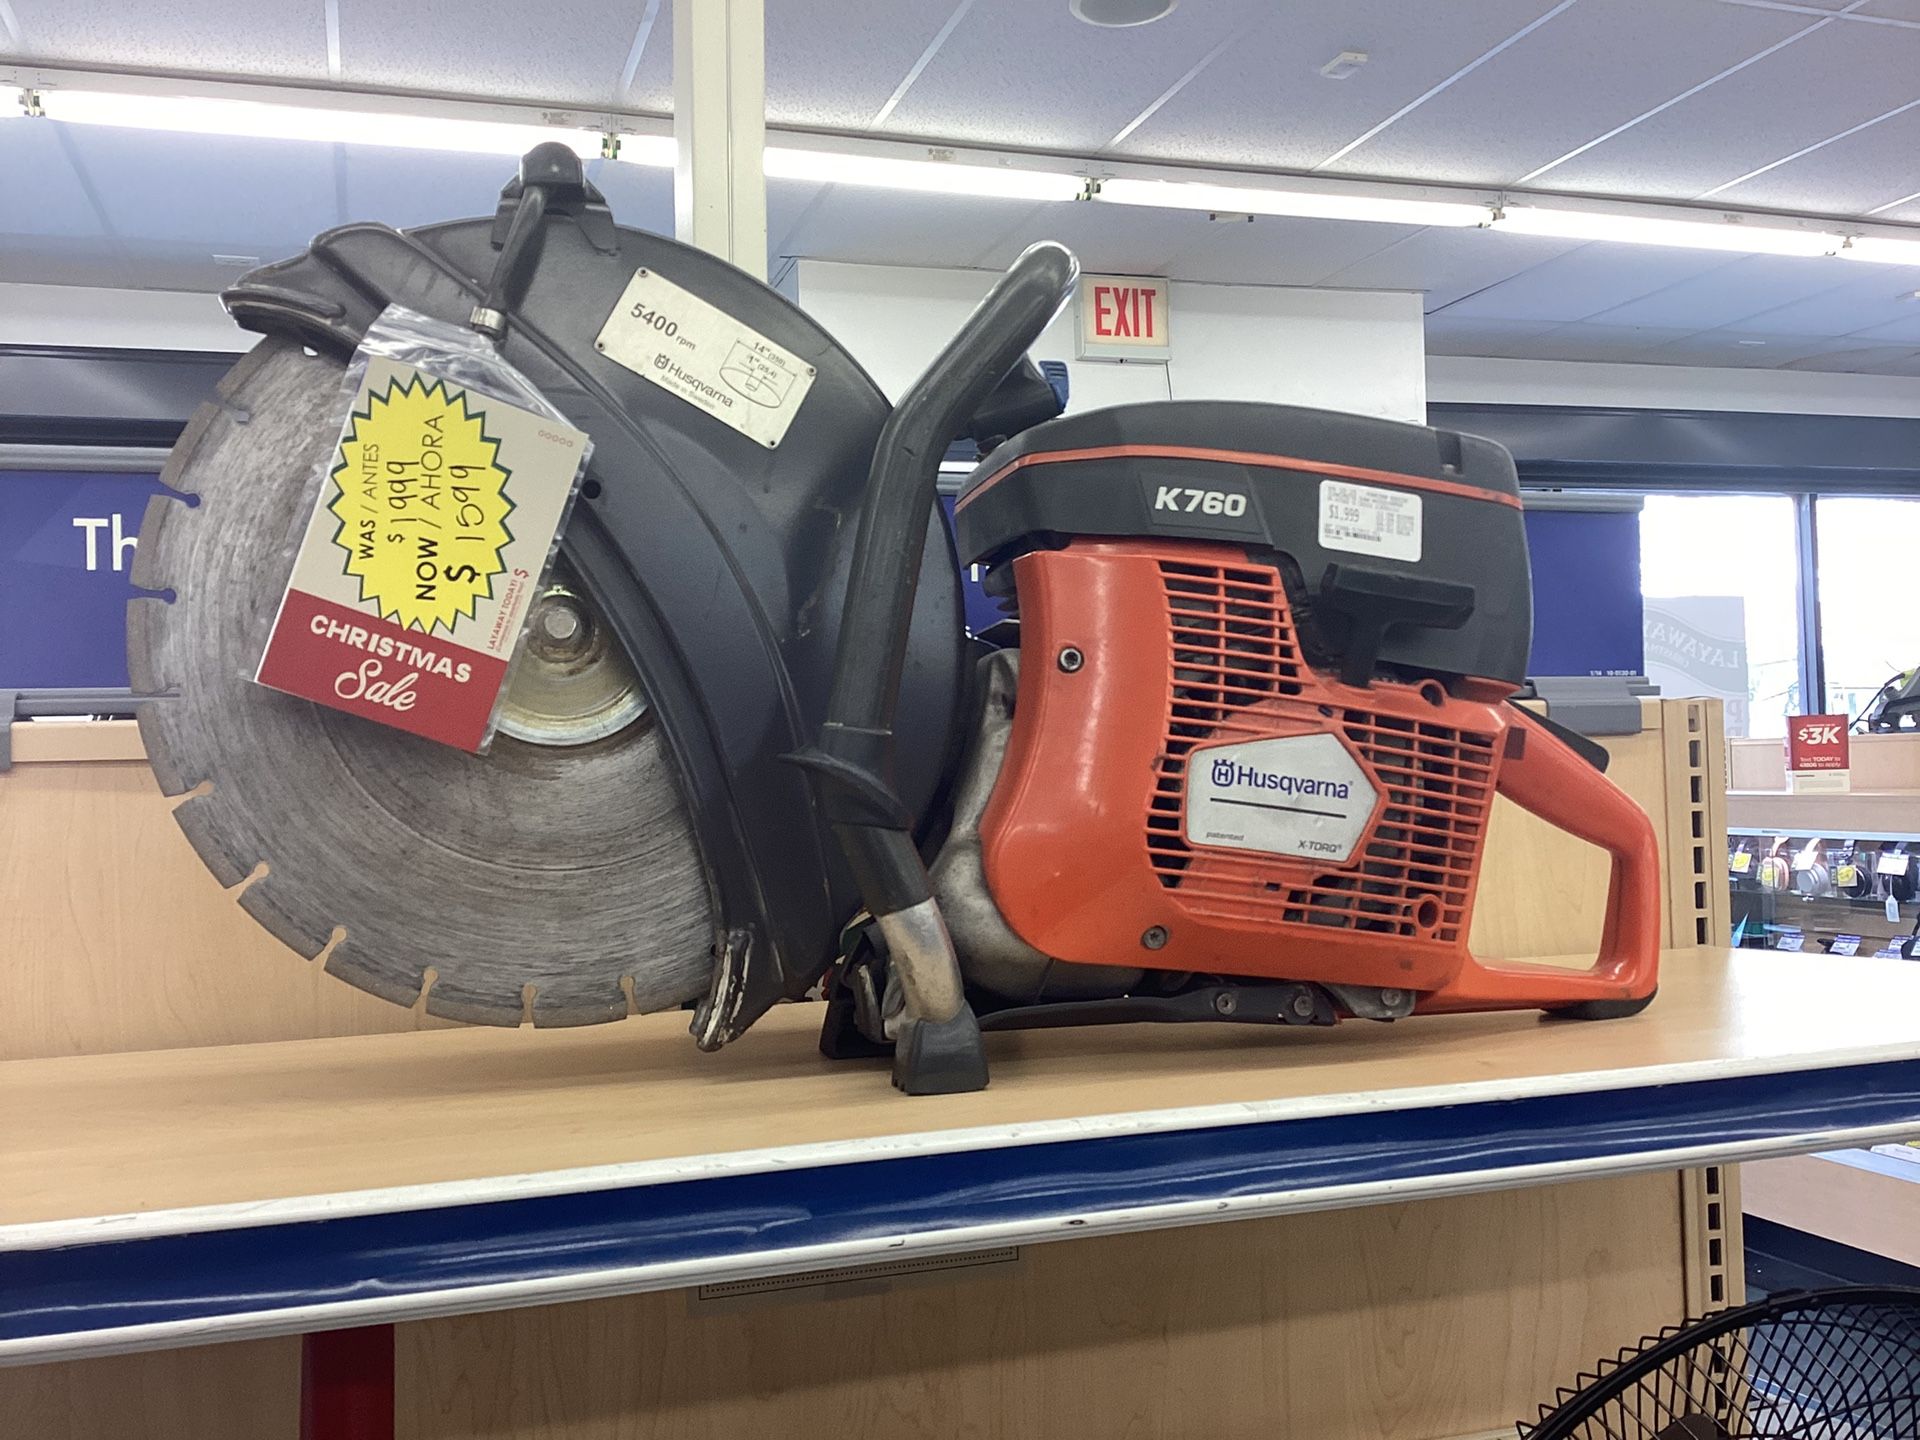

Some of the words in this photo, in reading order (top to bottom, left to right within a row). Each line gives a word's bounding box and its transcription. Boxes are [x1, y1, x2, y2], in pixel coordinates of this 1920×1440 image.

[630, 302, 678, 337] 5400
[675, 335, 697, 351] rpm
[1094, 286, 1156, 338] EXIT
[667, 362, 734, 408] Husqvarna
[362, 443, 380, 500] ANTES
[419, 414, 446, 512] AHORA
[358, 519, 376, 560] WAS
[415, 536, 439, 601] NOW
[487, 609, 506, 650] LAYAWAY
[502, 579, 518, 608] TODAY!
[310, 613, 473, 683] CHRISTMAS
[334, 658, 418, 713] Sale
[1797, 726, 1842, 745] $3K
[1237, 765, 1349, 800] Husqvarna
[1206, 831, 1245, 842] patented
